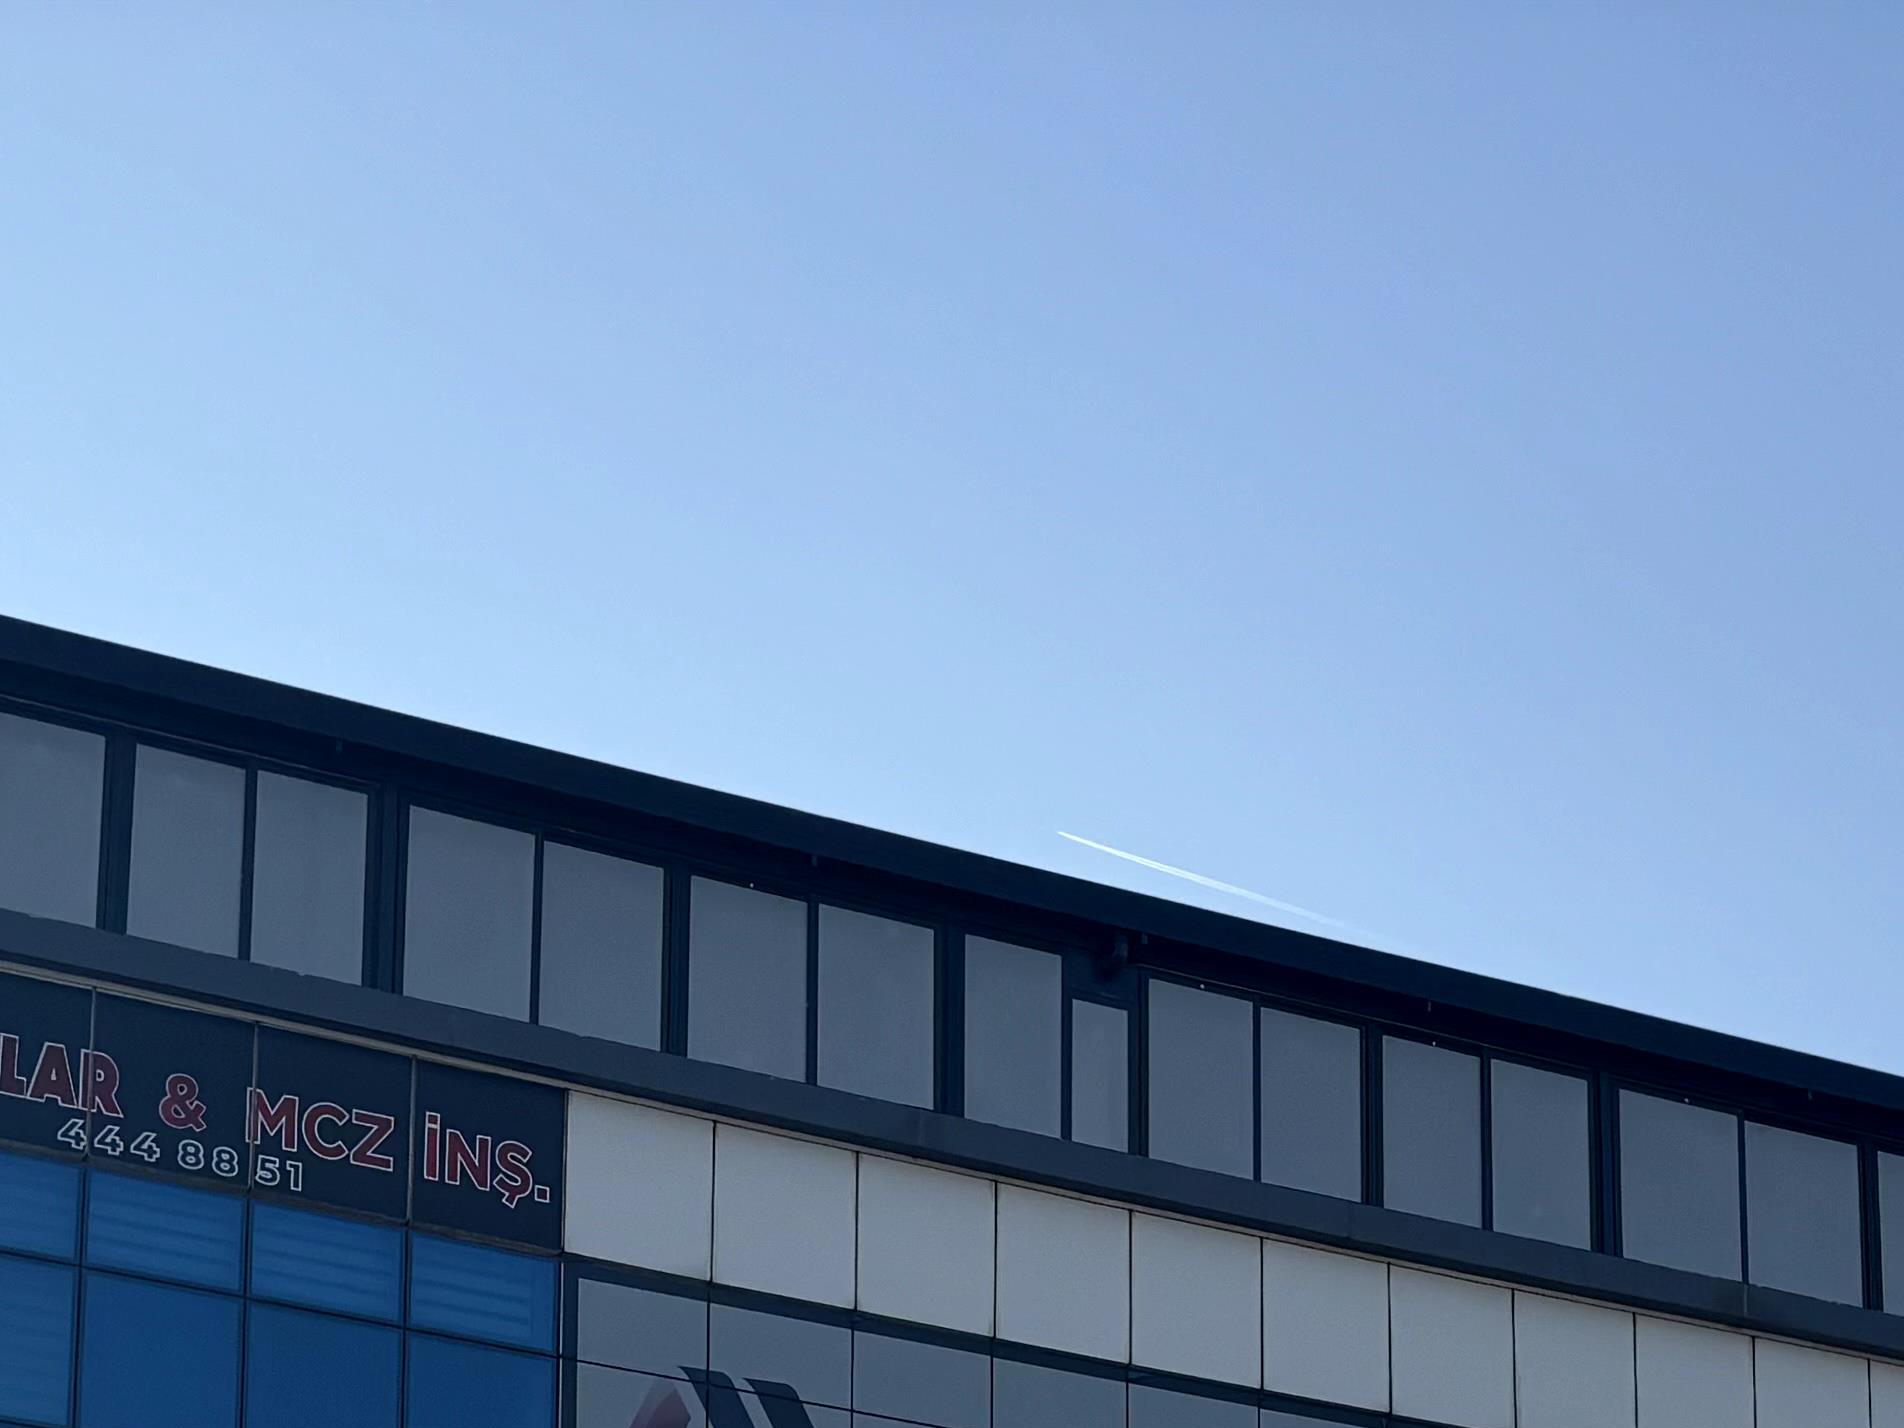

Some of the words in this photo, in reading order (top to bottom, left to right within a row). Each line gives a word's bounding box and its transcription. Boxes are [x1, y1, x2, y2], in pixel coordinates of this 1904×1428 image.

[58, 1119, 159, 1163] 444
[177, 1138, 237, 1177] 88
[255, 1157, 302, 1191] 51
[159, 1074, 206, 1131] &
[251, 1087, 394, 1172] MCZ
[425, 1111, 550, 1208] İNŞ.
